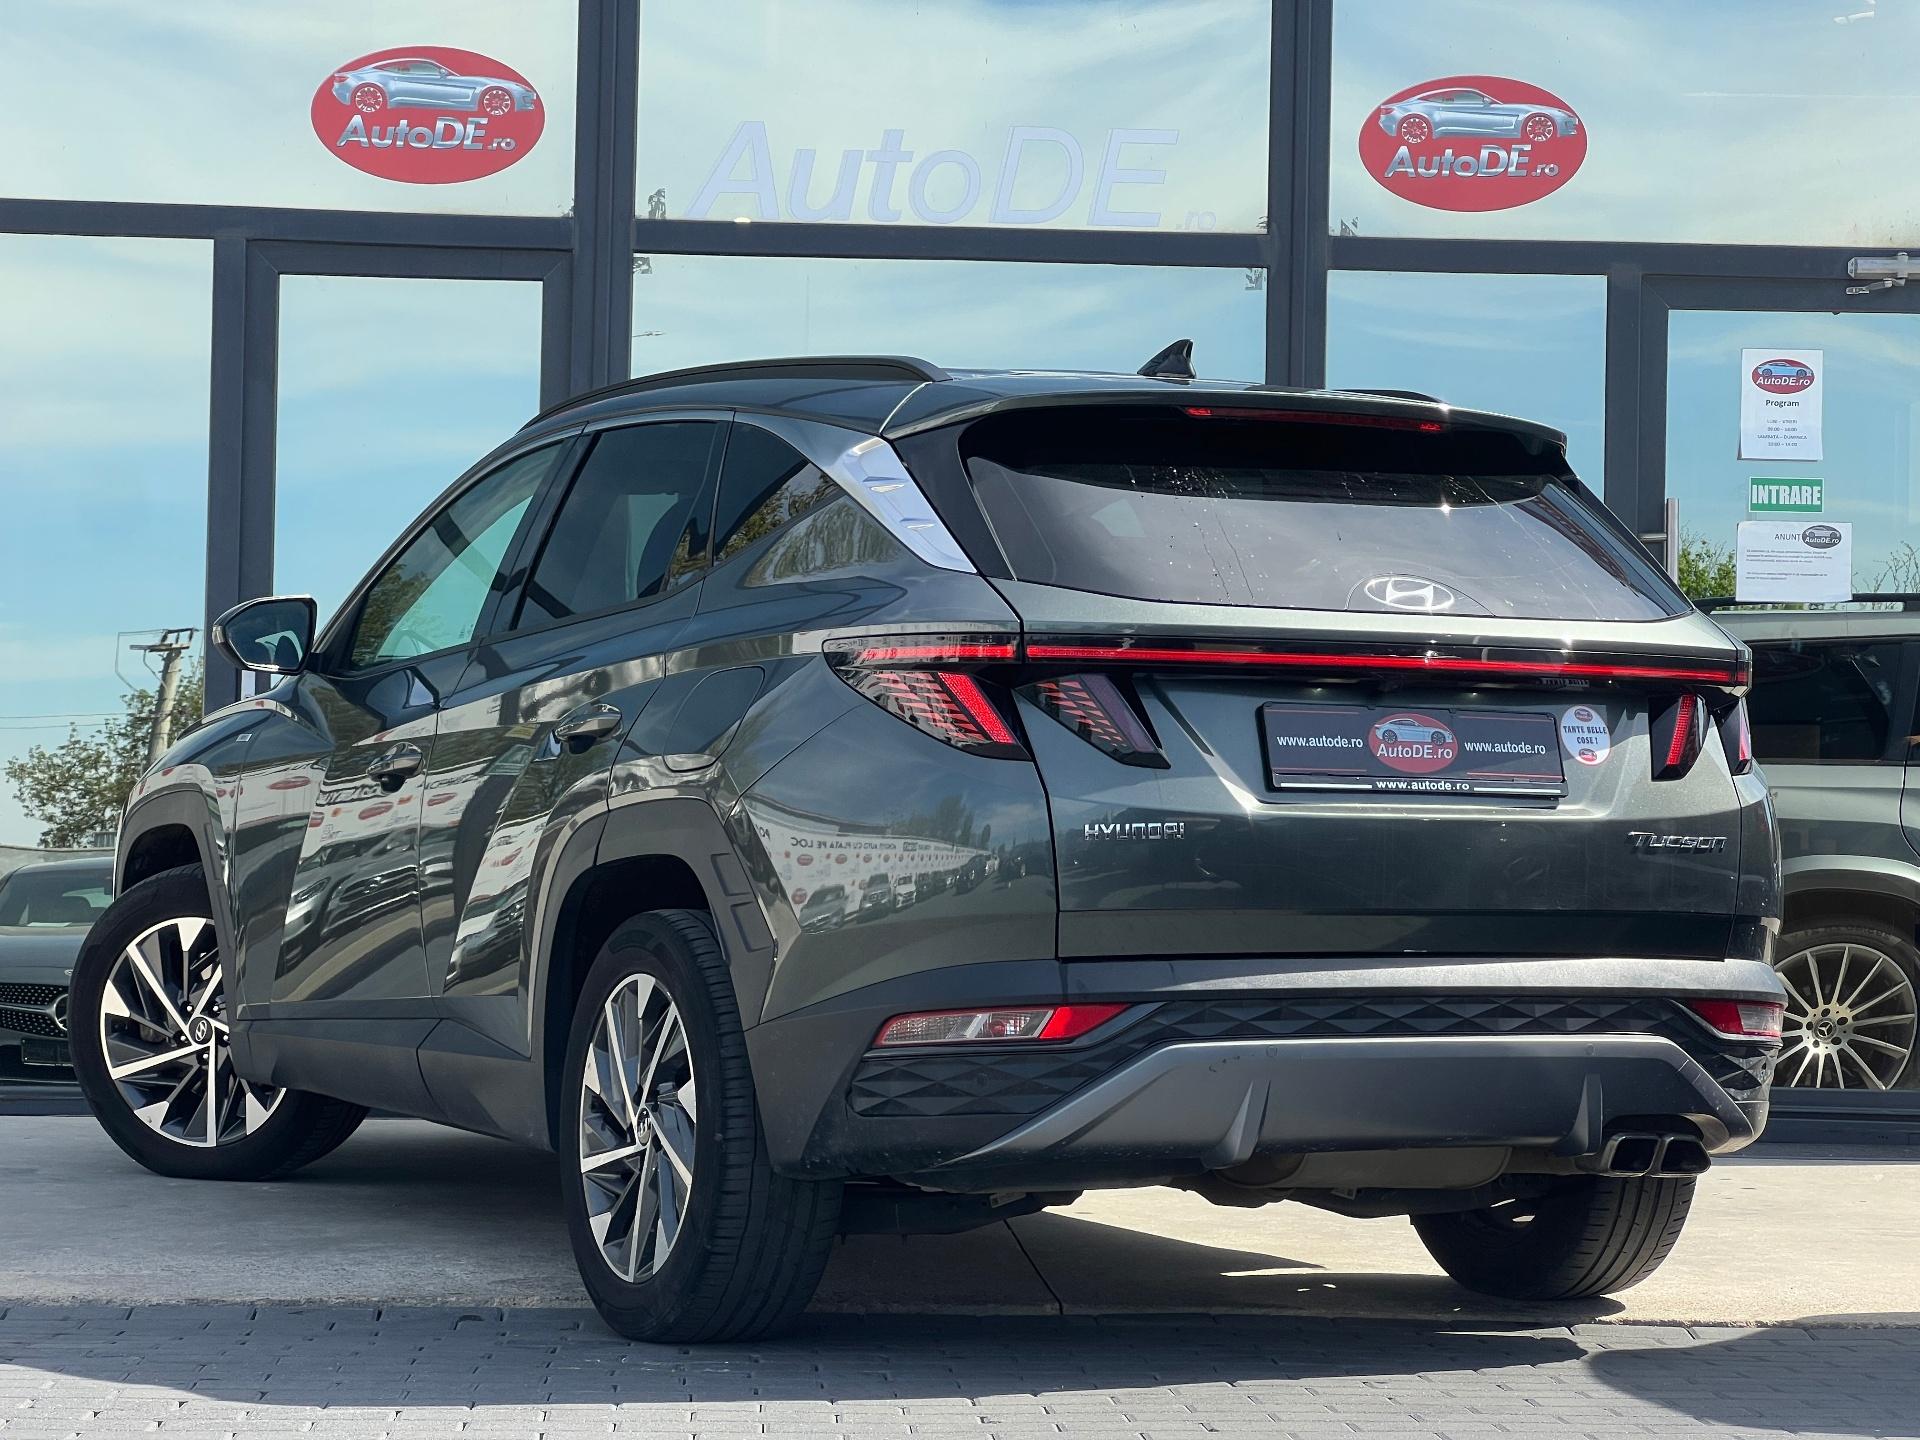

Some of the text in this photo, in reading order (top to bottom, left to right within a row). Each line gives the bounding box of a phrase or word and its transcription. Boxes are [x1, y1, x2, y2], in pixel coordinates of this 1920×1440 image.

[1756, 375, 1811, 387] AutoDE.ro
[1765, 399, 1800, 408] Program
[1752, 484, 1821, 505] INTRARE
[1804, 536, 1840, 544] AutoDE.ro
[1563, 725, 1607, 734] TANTE BELLE
[1276, 734, 1364, 749] www.autode.ro
[1464, 741, 1546, 755] www.autode.ro
[1376, 742, 1453, 760] AutoDE.ro
[1376, 779, 1470, 791] www.autode.ro
[1084, 822, 1185, 840] HYUNDAI
